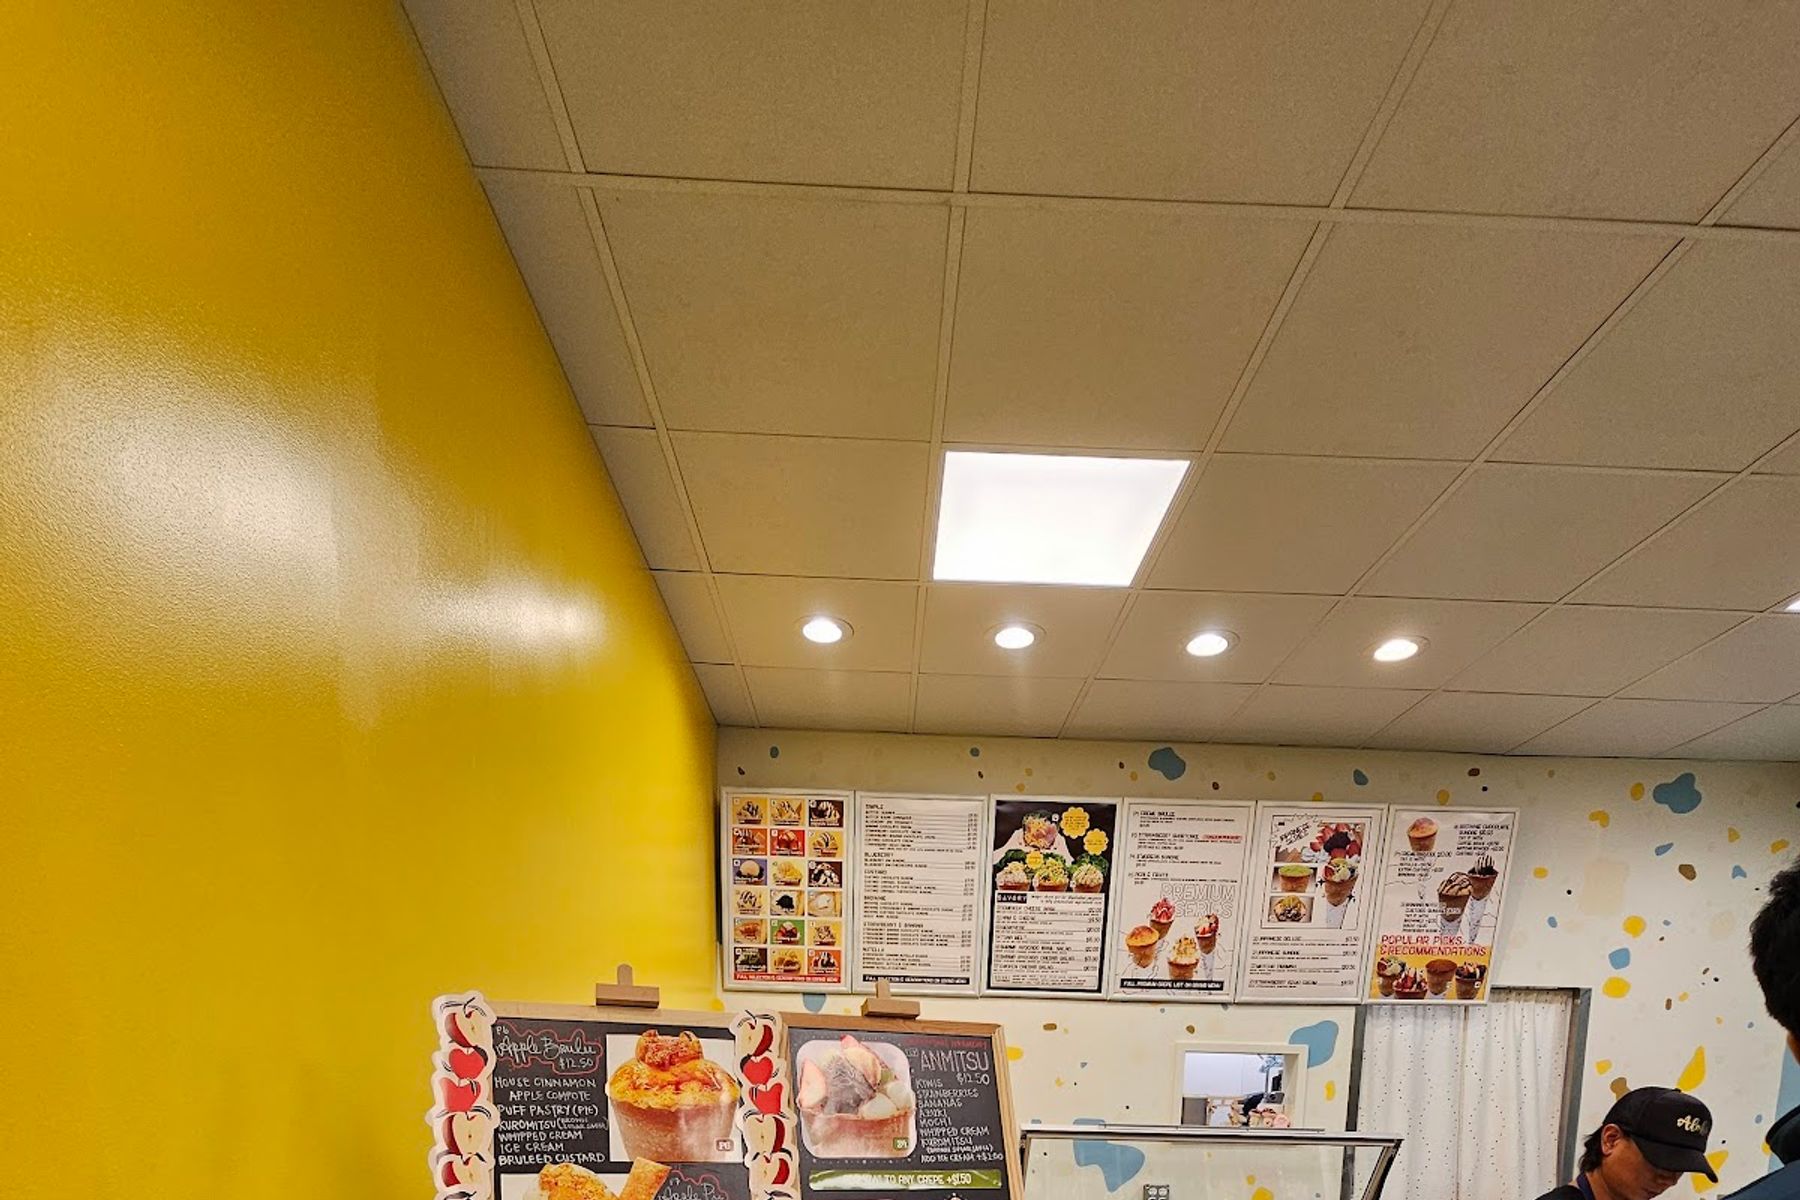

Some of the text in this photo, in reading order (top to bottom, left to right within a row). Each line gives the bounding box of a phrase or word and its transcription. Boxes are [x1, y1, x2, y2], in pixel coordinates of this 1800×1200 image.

[1160, 882, 1236, 901] PREMIUM
[997, 894, 1026, 902] SAVORY
[1381, 934, 1463, 945] POPULAR PICKS
[560, 1058, 594, 1070] $12.50
[920, 1050, 990, 1072] ANMITSU
[494, 1076, 596, 1088] HOUSE CINNAMON
[916, 1078, 944, 1089] KIWIS
[956, 1072, 990, 1085] $12.50
[509, 1090, 591, 1102] APPLE COMPOTE
[916, 1088, 979, 1099] STRAWBERRIES
[918, 1098, 962, 1108] BANANAS
[496, 1104, 598, 1118] PUFF PASTRY (PIE)
[499, 1120, 556, 1132] KUROMITSU
[920, 1117, 952, 1127] MOCHI
[498, 1130, 584, 1142] WHIPPED CREAM
[920, 1126, 990, 1137] WHIPPED CREAM
[500, 1142, 564, 1154] ICE CREAM
[920, 1136, 973, 1148] KUROMITSU
[498, 1152, 606, 1166] BRULEED CUSTARD
[950, 1153, 974, 1162] CREAM
[884, 1174, 896, 1185] TO
[898, 1174, 914, 1185] ANY
[916, 1174, 944, 1185] CREPE
